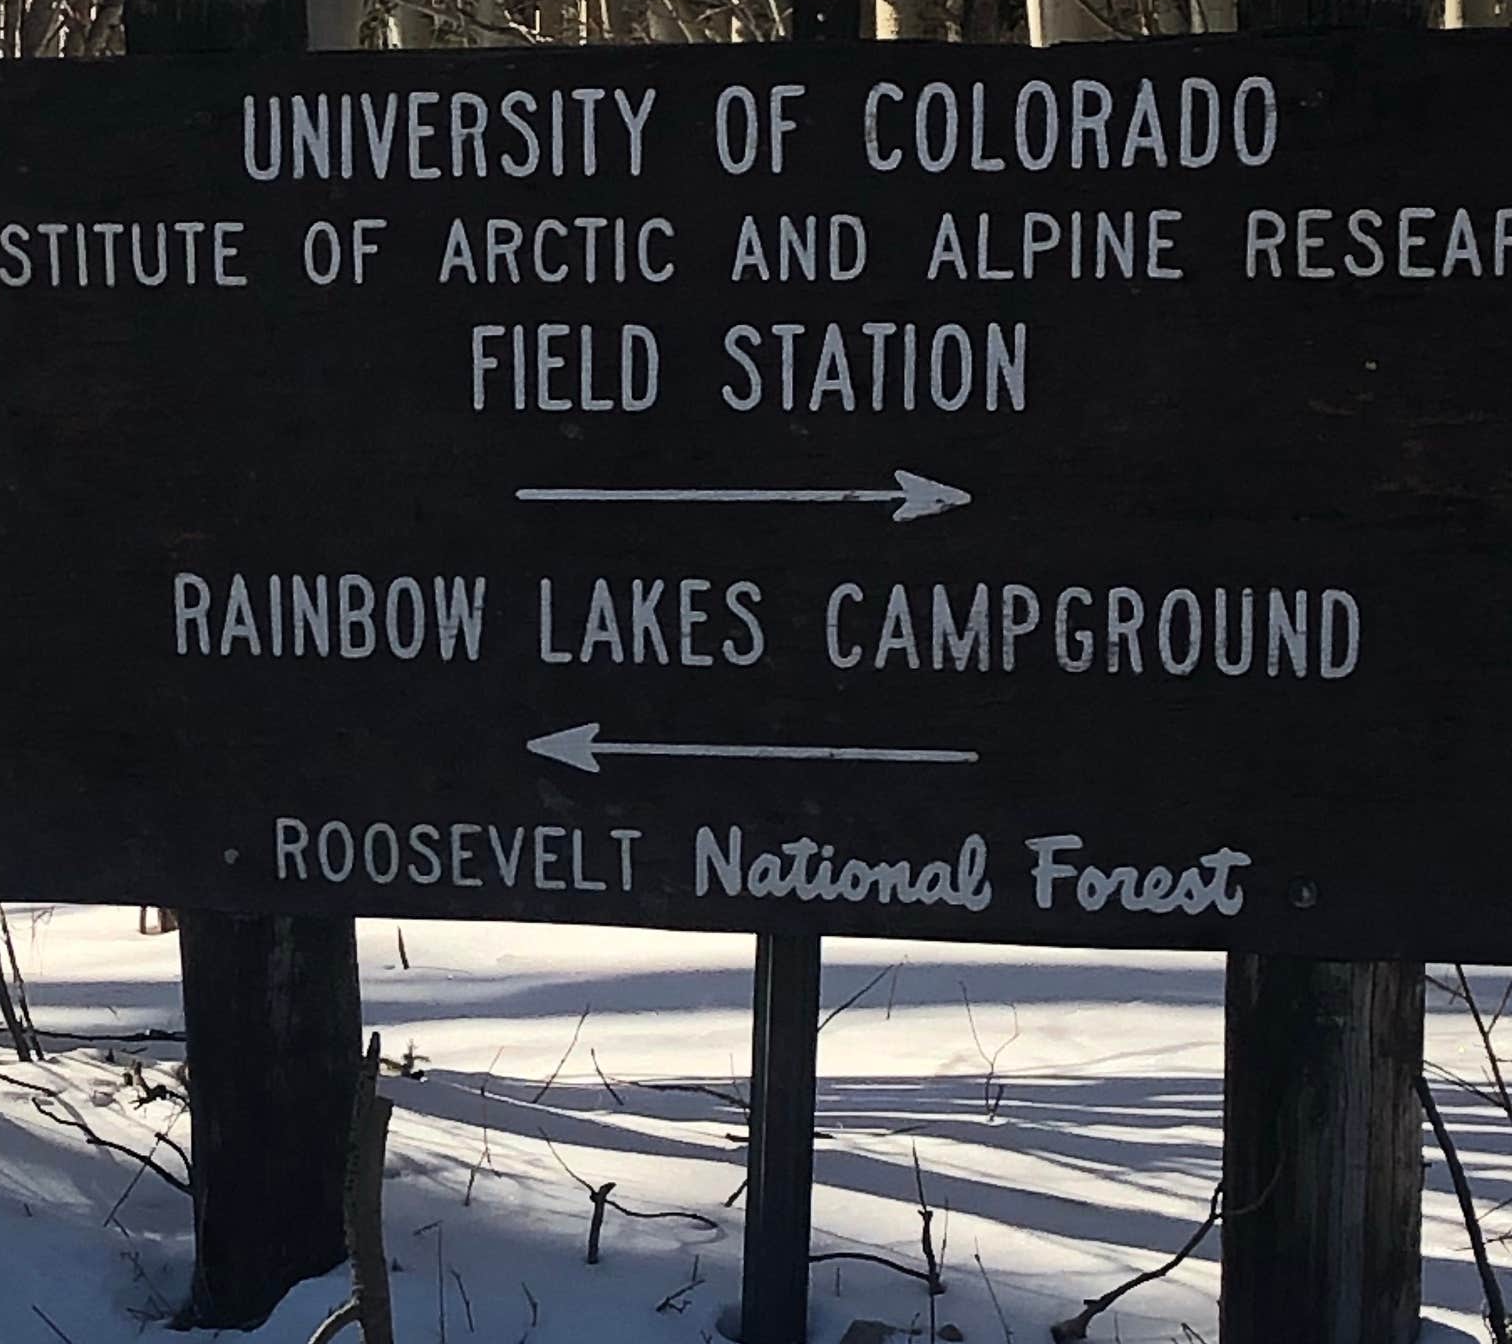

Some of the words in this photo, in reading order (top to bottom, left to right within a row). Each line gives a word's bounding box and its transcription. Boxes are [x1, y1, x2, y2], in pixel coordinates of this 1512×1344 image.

[243, 88, 656, 181] UNIVERSITY
[715, 84, 806, 175] OF
[864, 75, 1278, 173] COLORADO
[304, 218, 388, 285] OF
[439, 217, 675, 284] ARCTIC
[731, 214, 867, 282] AND
[927, 209, 1184, 281] ALPINE
[472, 323, 659, 412] FIELD
[721, 322, 1027, 412] STATION
[174, 572, 486, 661] RAINBOW
[540, 577, 764, 666] LAKES
[826, 582, 1361, 679] CAMPGROUND
[276, 817, 642, 891] ROOSEVELT
[695, 825, 992, 912] National
[1025, 834, 1252, 916] Forest
